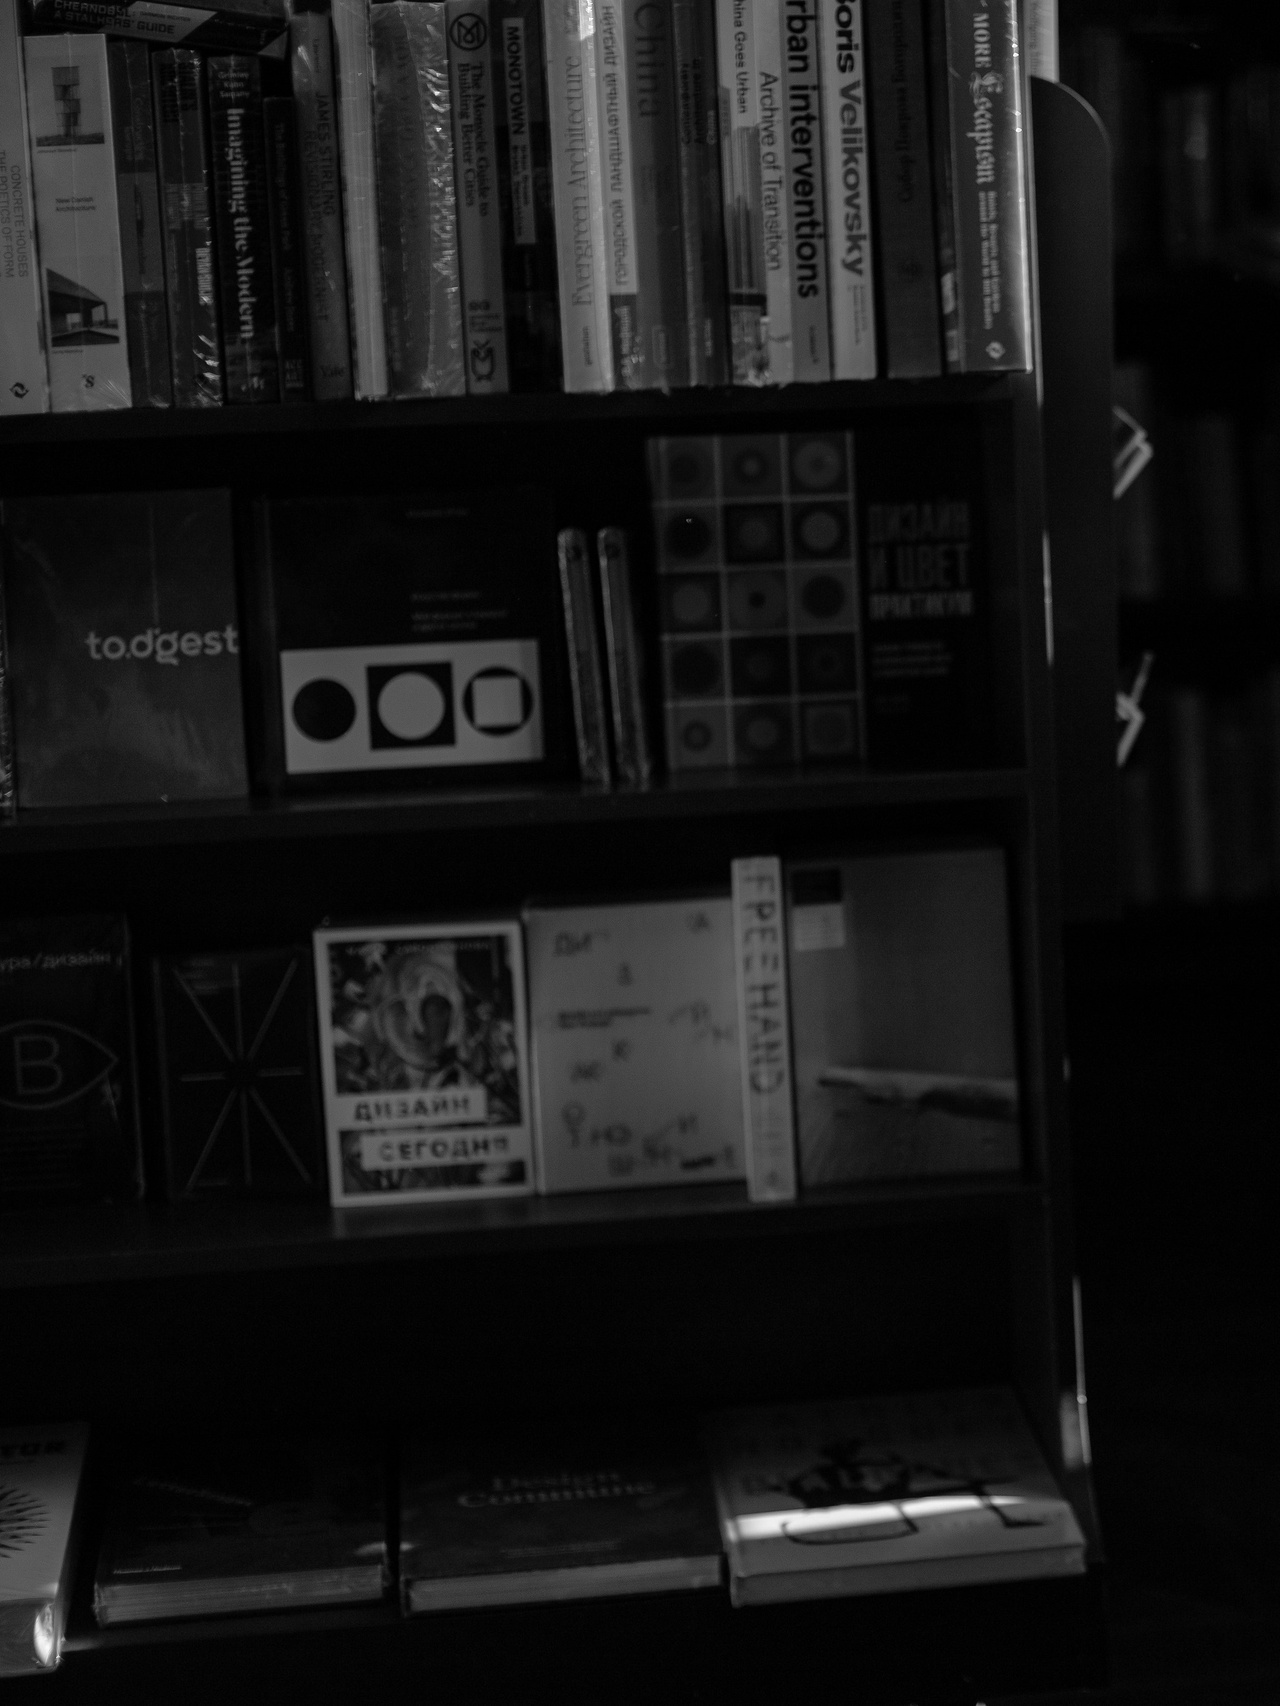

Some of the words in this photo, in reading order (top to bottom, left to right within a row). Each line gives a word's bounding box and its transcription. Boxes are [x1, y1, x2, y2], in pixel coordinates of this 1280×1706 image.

[137, 21, 175, 34] GUIDE
[599, 5, 618, 66] ДИЗАЙН
[733, 0, 747, 28] hina
[787, 0, 816, 73] rban
[635, 4, 665, 117] China
[735, 32, 748, 68] Goes
[973, 13, 991, 69] MORE
[458, 63, 474, 120] Building
[471, 61, 485, 90] The
[506, 26, 524, 135] MONOTOWN
[736, 71, 750, 114] Urban
[315, 92, 333, 141] JAMES
[473, 94, 489, 153] Monocle
[565, 56, 588, 190] Architecture
[603, 73, 624, 193] ЛАНДШАФТНЫЙ
[760, 71, 779, 146] Archive
[966, 72, 1003, 185] Escapism
[225, 108, 250, 212] Imagining
[463, 124, 477, 166] Better
[762, 152, 780, 171] of
[0, 175, 11, 224] POETICS
[10, 165, 25, 227] CONCRETE
[319, 146, 336, 216] STIRLING
[466, 170, 480, 206] Cities
[477, 157, 492, 196] Guide
[789, 84, 826, 299] interventions
[839, 80, 867, 277] Velikovsky
[233, 216, 253, 251] the
[478, 200, 490, 216] to
[763, 177, 784, 271] Transition
[2, 226, 13, 246] OF
[16, 230, 29, 278] HOUSES
[568, 196, 592, 306] Evergreen
[3, 247, 14, 278] FORM
[236, 255, 257, 340] Modern
[0, 949, 111, 972] ура/дизайн
[354, 1095, 469, 1122] ДИЗАЙН
[0, 1440, 67, 1458] TOR
